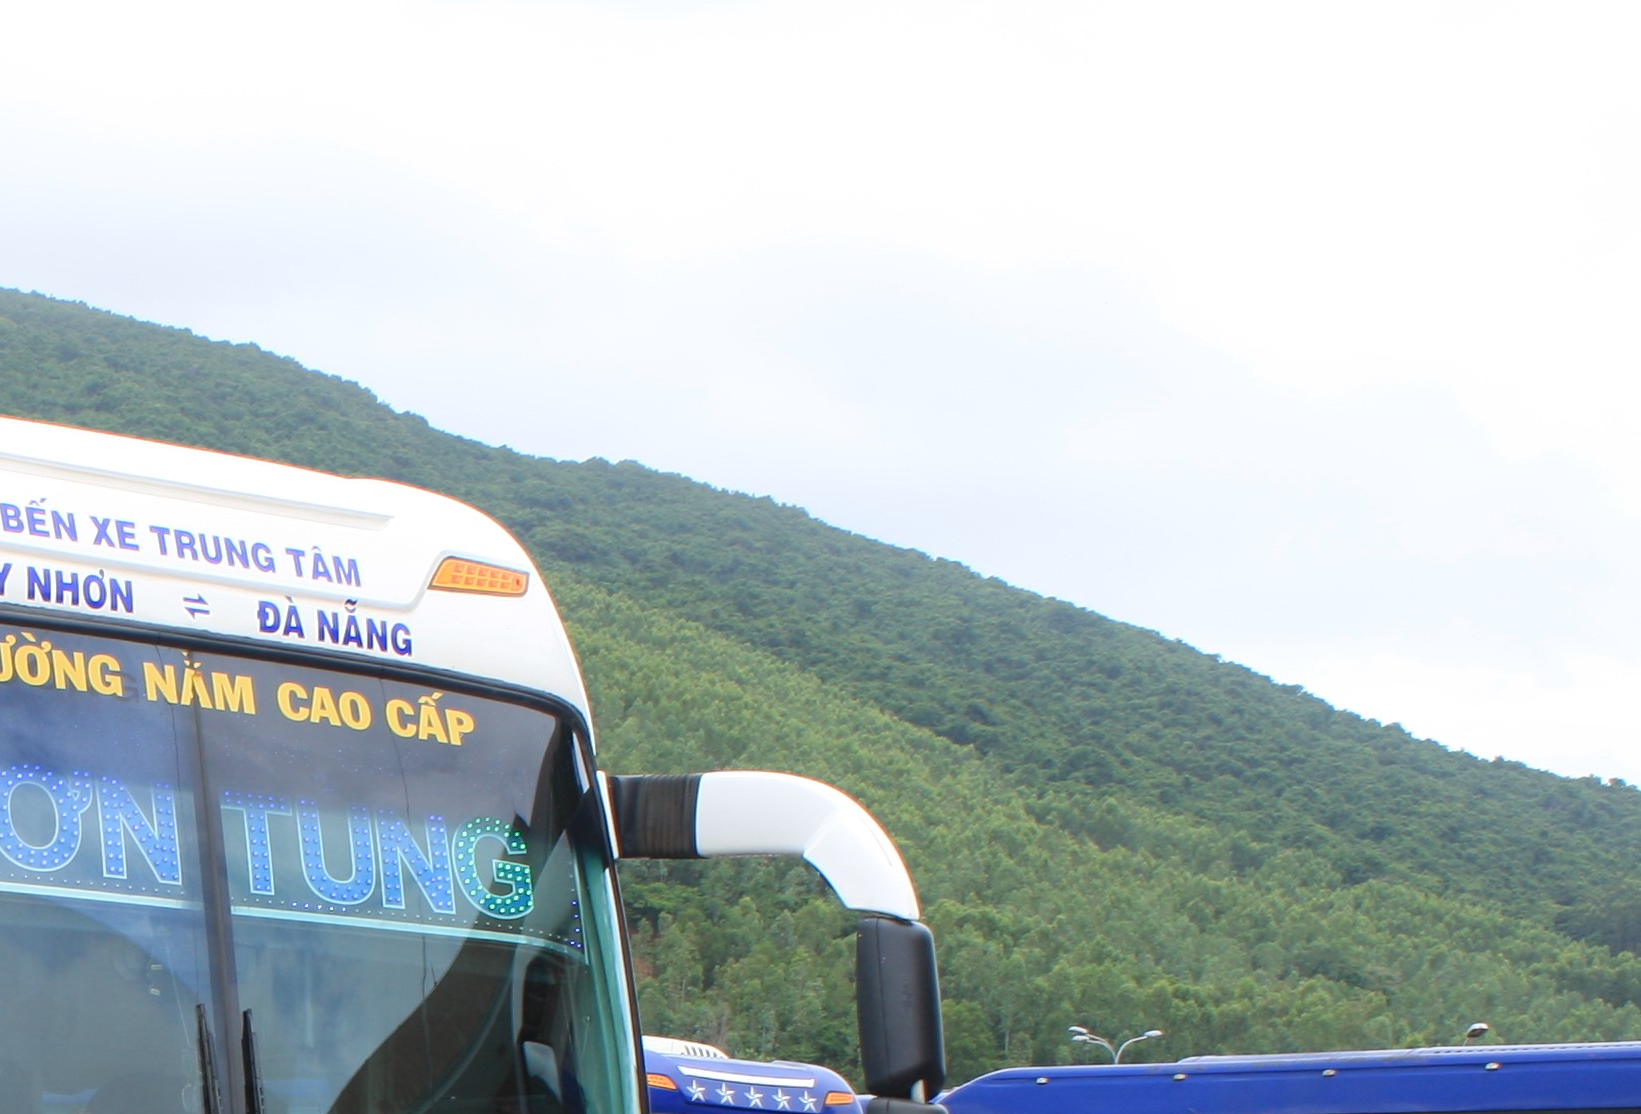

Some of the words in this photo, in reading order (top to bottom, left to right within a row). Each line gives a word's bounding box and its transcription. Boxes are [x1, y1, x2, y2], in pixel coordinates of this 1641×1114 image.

[88, 515, 139, 551] XE
[148, 525, 276, 574] TRUNG
[284, 545, 361, 588] TÂM
[25, 567, 134, 614] NHƠN
[258, 595, 304, 639] ĐÀ
[316, 599, 413, 656] NẴNG
[278, 682, 372, 730] CAO
[385, 693, 475, 746] CẤP
